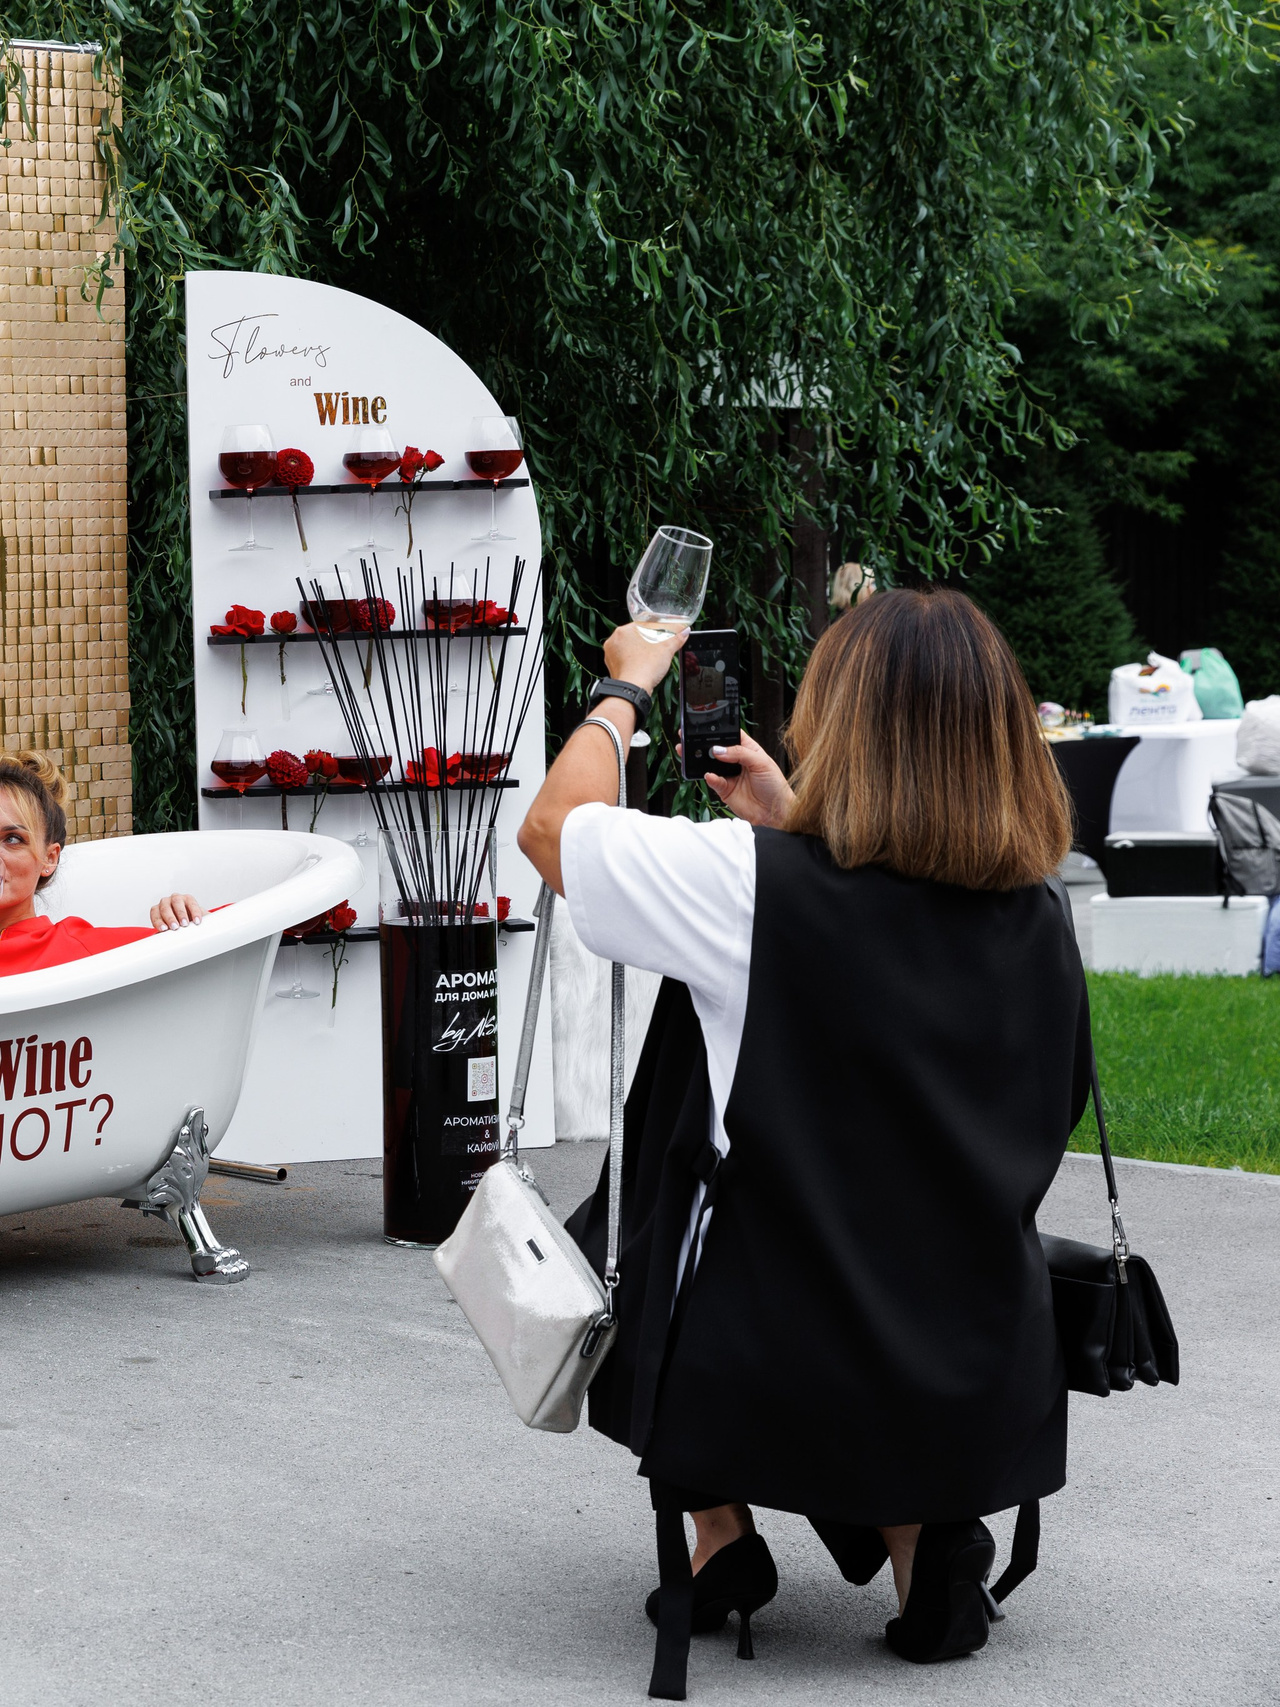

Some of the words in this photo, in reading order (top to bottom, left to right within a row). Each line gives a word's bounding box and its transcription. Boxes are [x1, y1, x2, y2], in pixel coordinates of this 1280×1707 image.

[208, 313, 331, 379] Flowers
[289, 376, 312, 387] and
[314, 391, 387, 425] Wine
[434, 992, 460, 1003] ДЛЯ
[461, 990, 490, 1002] ДОМА
[432, 1011, 467, 1052] by
[484, 1129, 490, 1139] &
